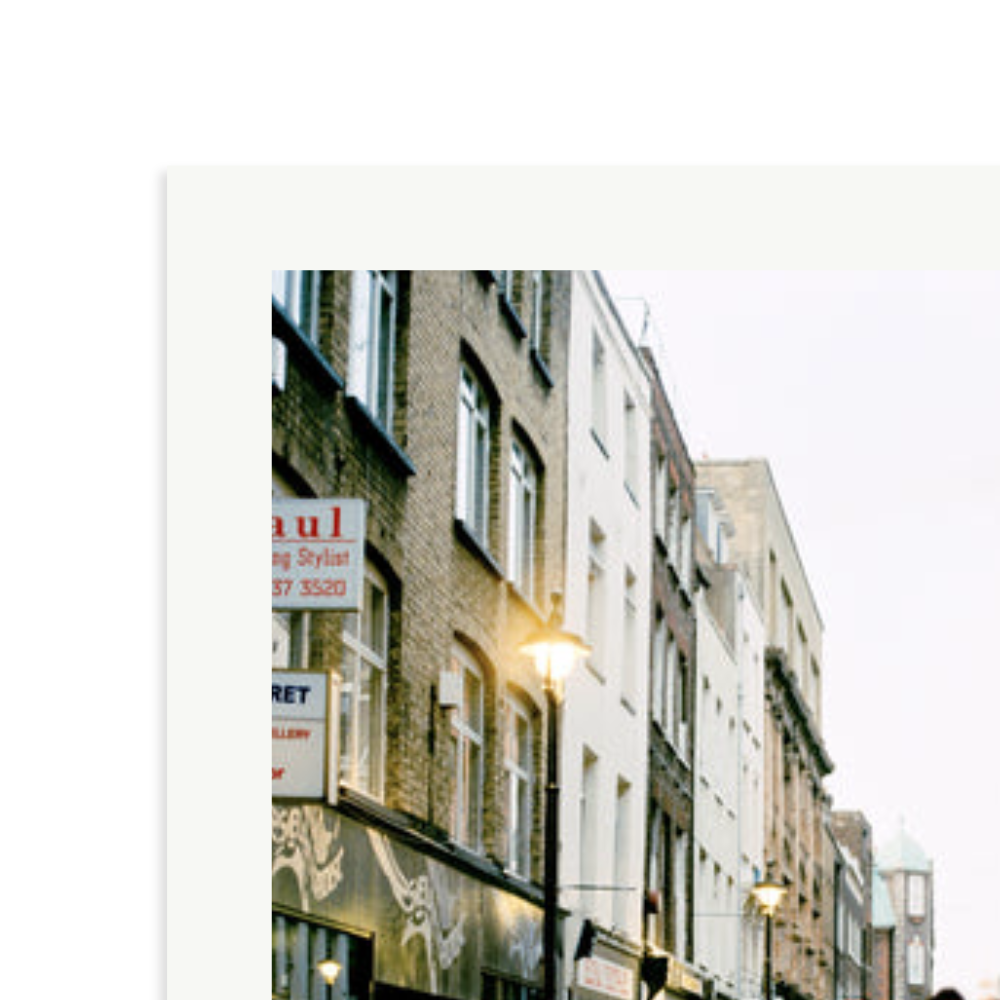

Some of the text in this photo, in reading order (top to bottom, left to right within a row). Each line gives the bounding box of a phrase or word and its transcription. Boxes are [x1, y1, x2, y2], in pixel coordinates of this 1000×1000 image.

[298, 547, 350, 569] Stylist
[300, 579, 347, 597] 3520
[272, 684, 311, 704] RET
